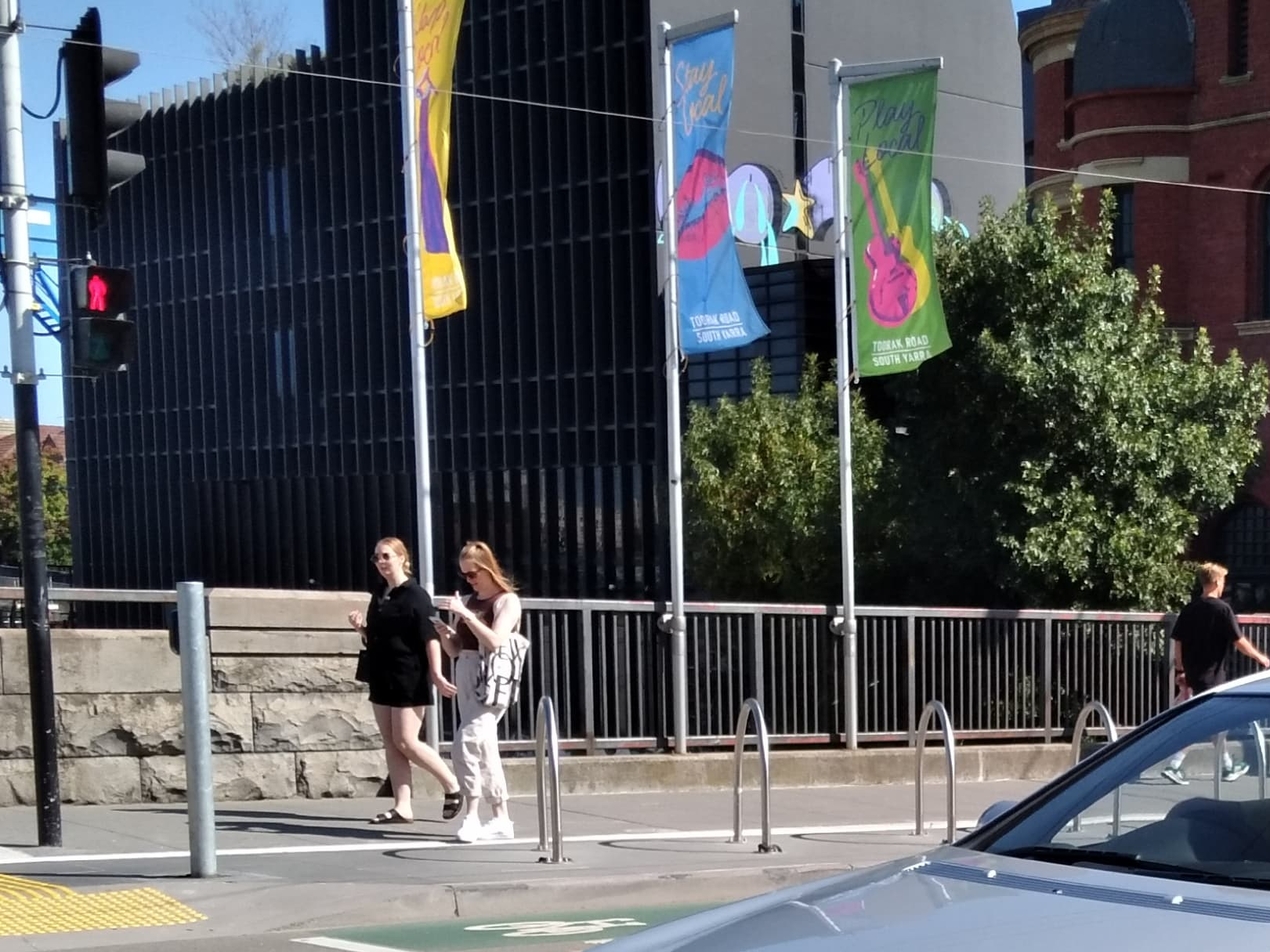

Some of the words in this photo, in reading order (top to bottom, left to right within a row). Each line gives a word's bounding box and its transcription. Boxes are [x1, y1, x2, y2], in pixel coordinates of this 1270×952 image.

[675, 60, 718, 107] Stay
[682, 74, 728, 136] Local
[854, 99, 919, 140] Play
[862, 111, 926, 166] Local
[689, 313, 720, 328] TOORAK
[719, 311, 741, 324] ROAD
[696, 330, 721, 343] SOUTH
[721, 327, 748, 340] YARRA
[872, 338, 904, 352] TOORAK
[905, 334, 929, 348] ROAD
[872, 353, 901, 366] SOUTH
[902, 350, 933, 363] YARRA
